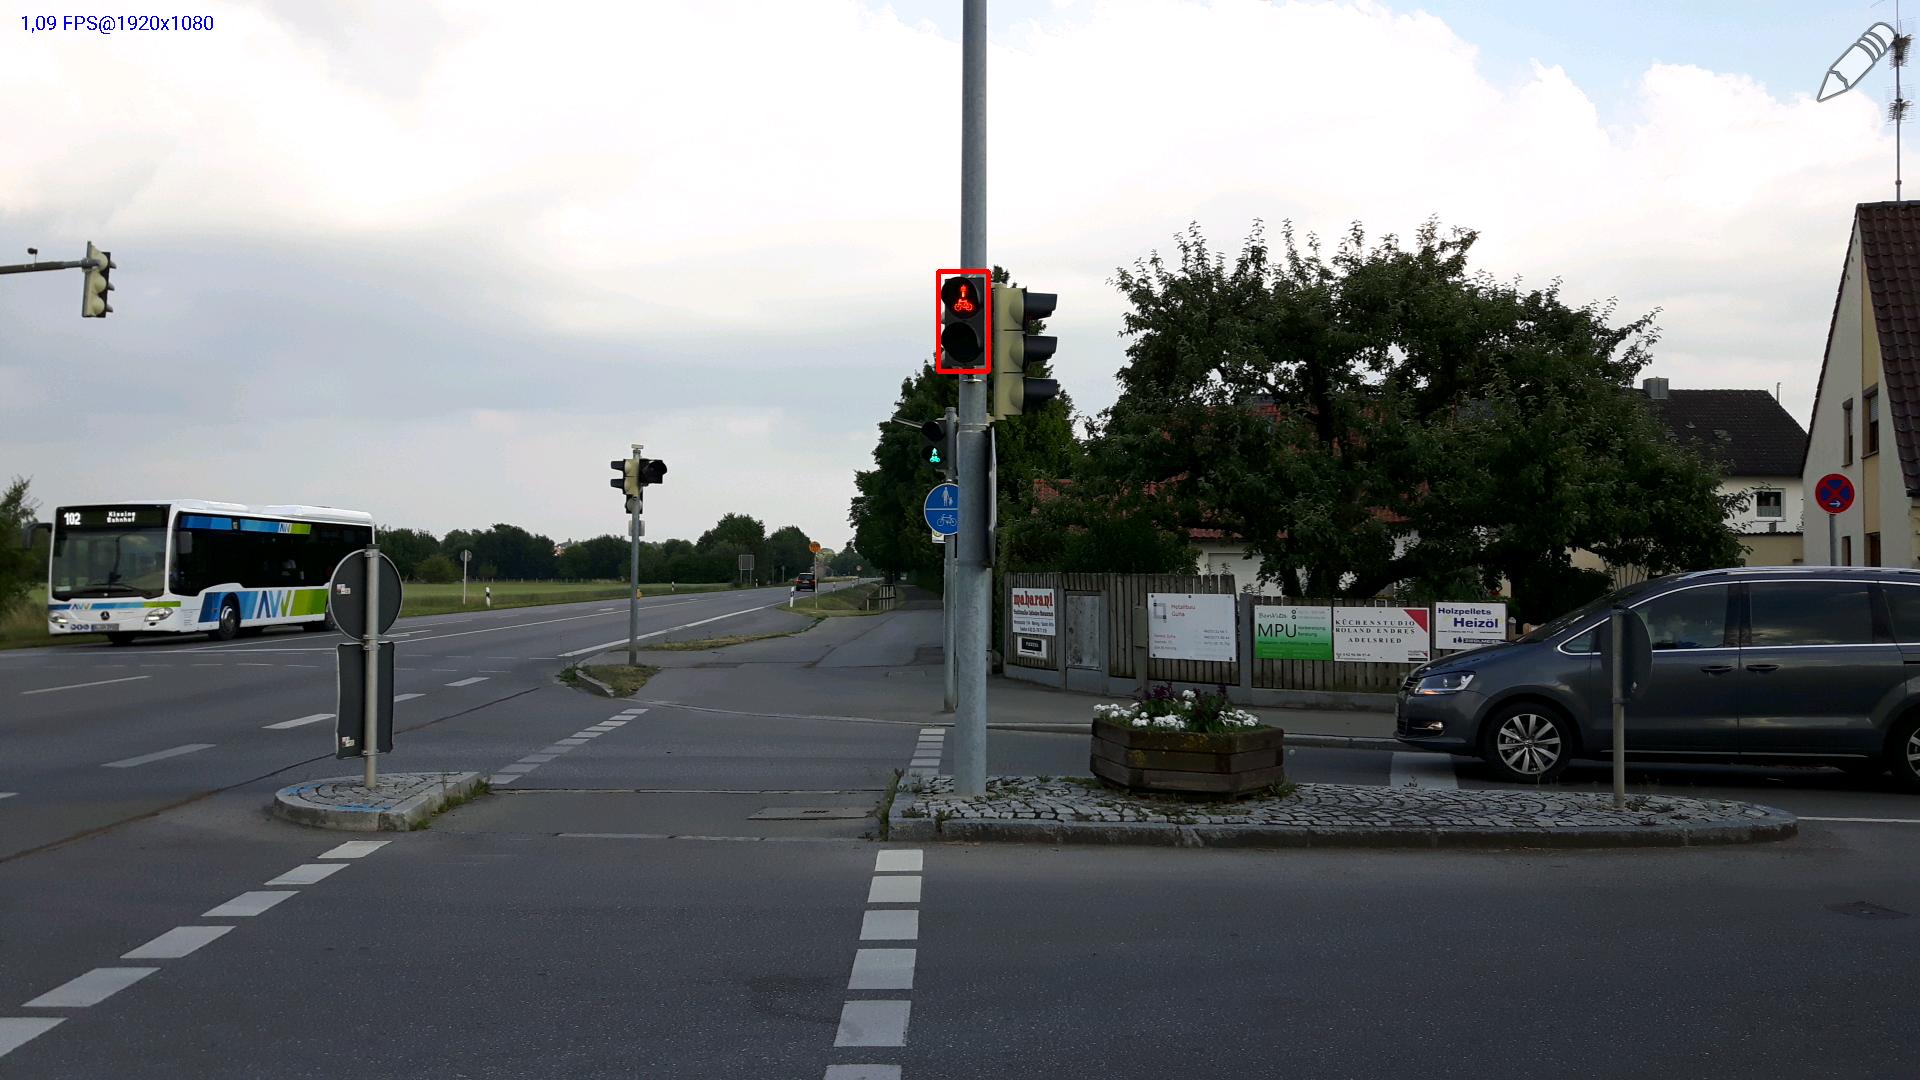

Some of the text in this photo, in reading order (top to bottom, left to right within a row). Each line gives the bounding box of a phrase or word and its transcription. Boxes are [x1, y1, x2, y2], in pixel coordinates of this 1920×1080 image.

[64, 512, 81, 525] 102
[1013, 590, 1054, 609] maharani
[1438, 607, 1492, 616] Holzpellets
[1335, 618, 1415, 626] KÜCHENSTUDIO
[1453, 617, 1499, 628] Heizöl
[1258, 623, 1297, 638] MPU
